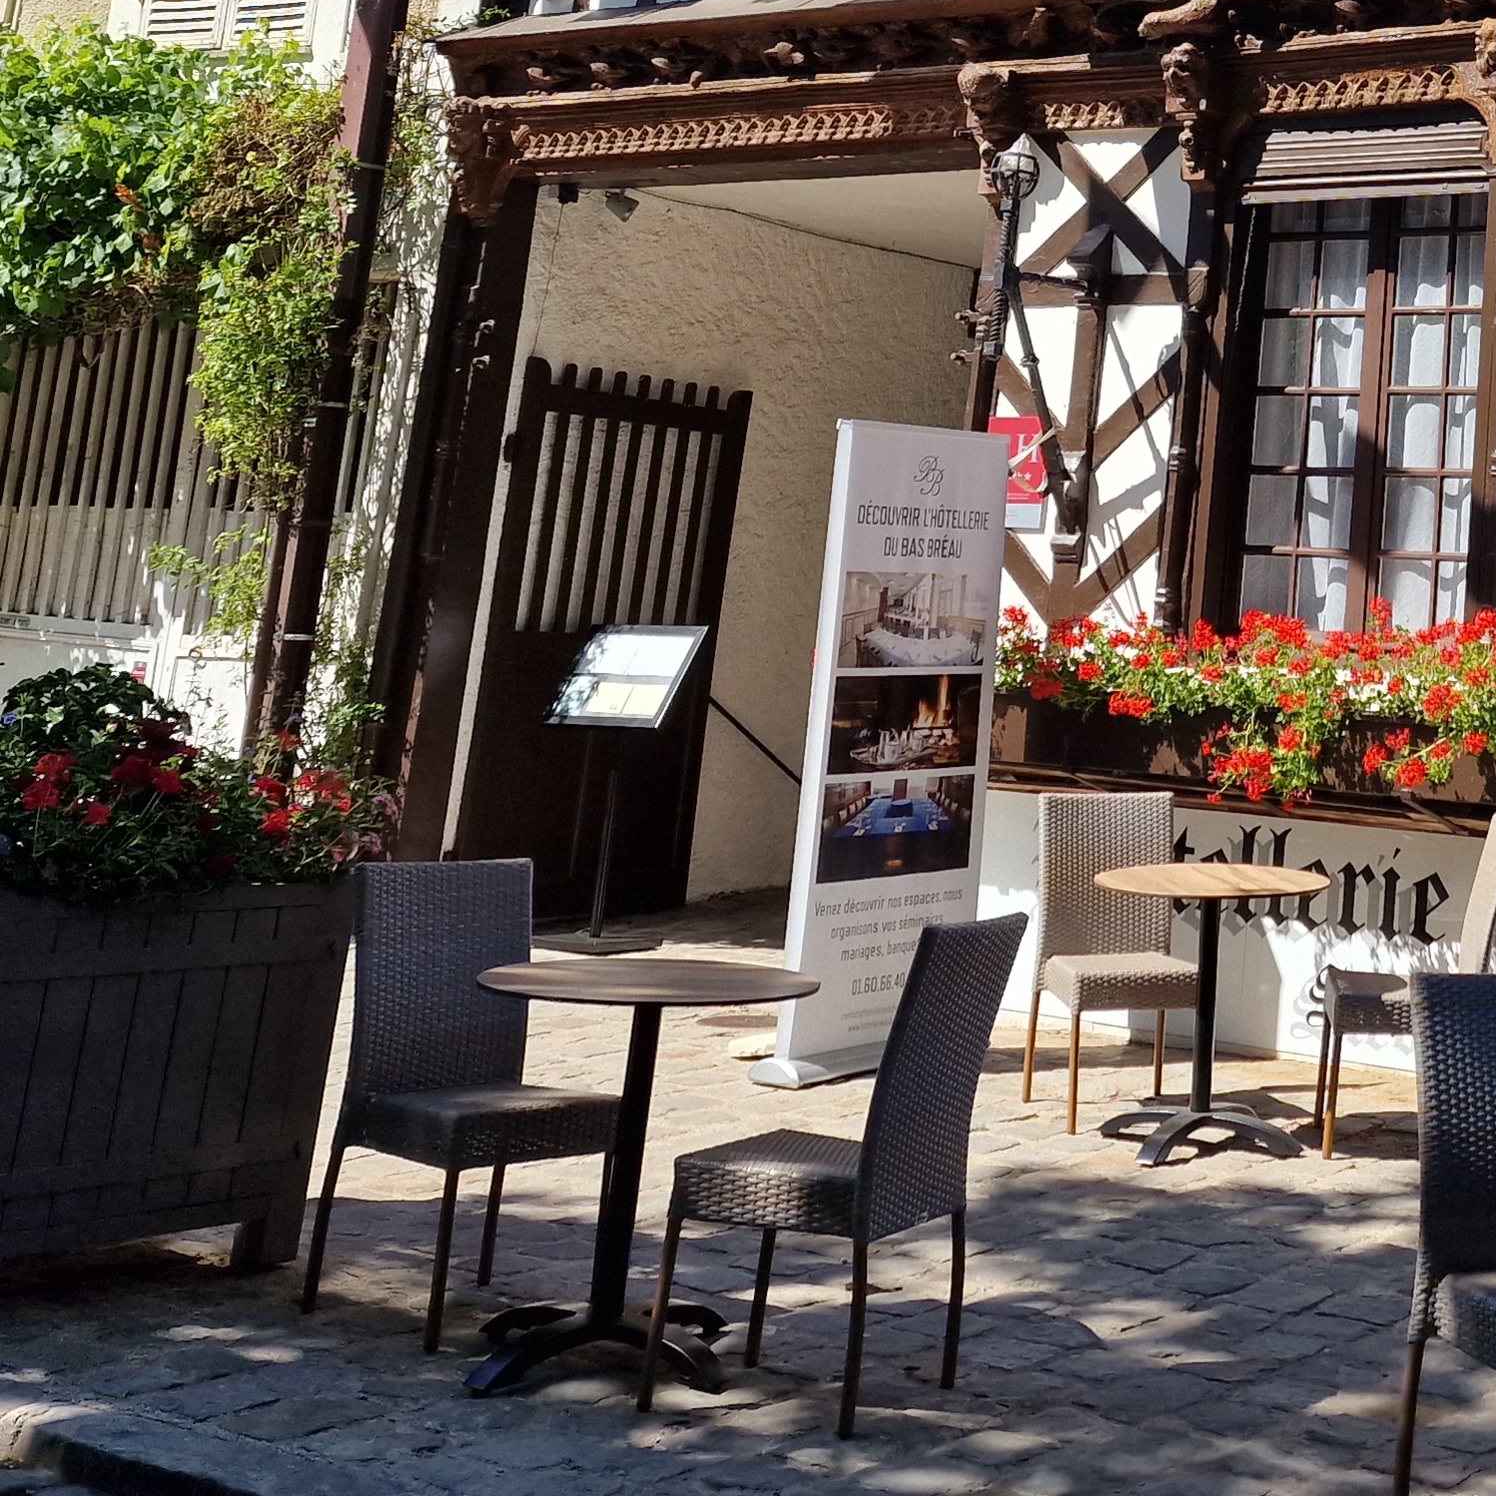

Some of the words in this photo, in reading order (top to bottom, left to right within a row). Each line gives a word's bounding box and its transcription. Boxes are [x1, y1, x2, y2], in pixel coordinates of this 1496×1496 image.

[857, 500, 921, 528] DÉCOUVRIR
[923, 505, 990, 530] L'HÔTELLERIE
[884, 537, 899, 556] DU
[901, 538, 925, 557] BAS
[927, 534, 963, 559] BRÉAU
[815, 901, 841, 917] Venez
[843, 895, 885, 914] découvrir
[887, 897, 902, 909] nos
[943, 889, 963, 902] nous
[830, 921, 878, 941] organisons
[882, 920, 897, 933] vos
[841, 944, 884, 961] mariages,
